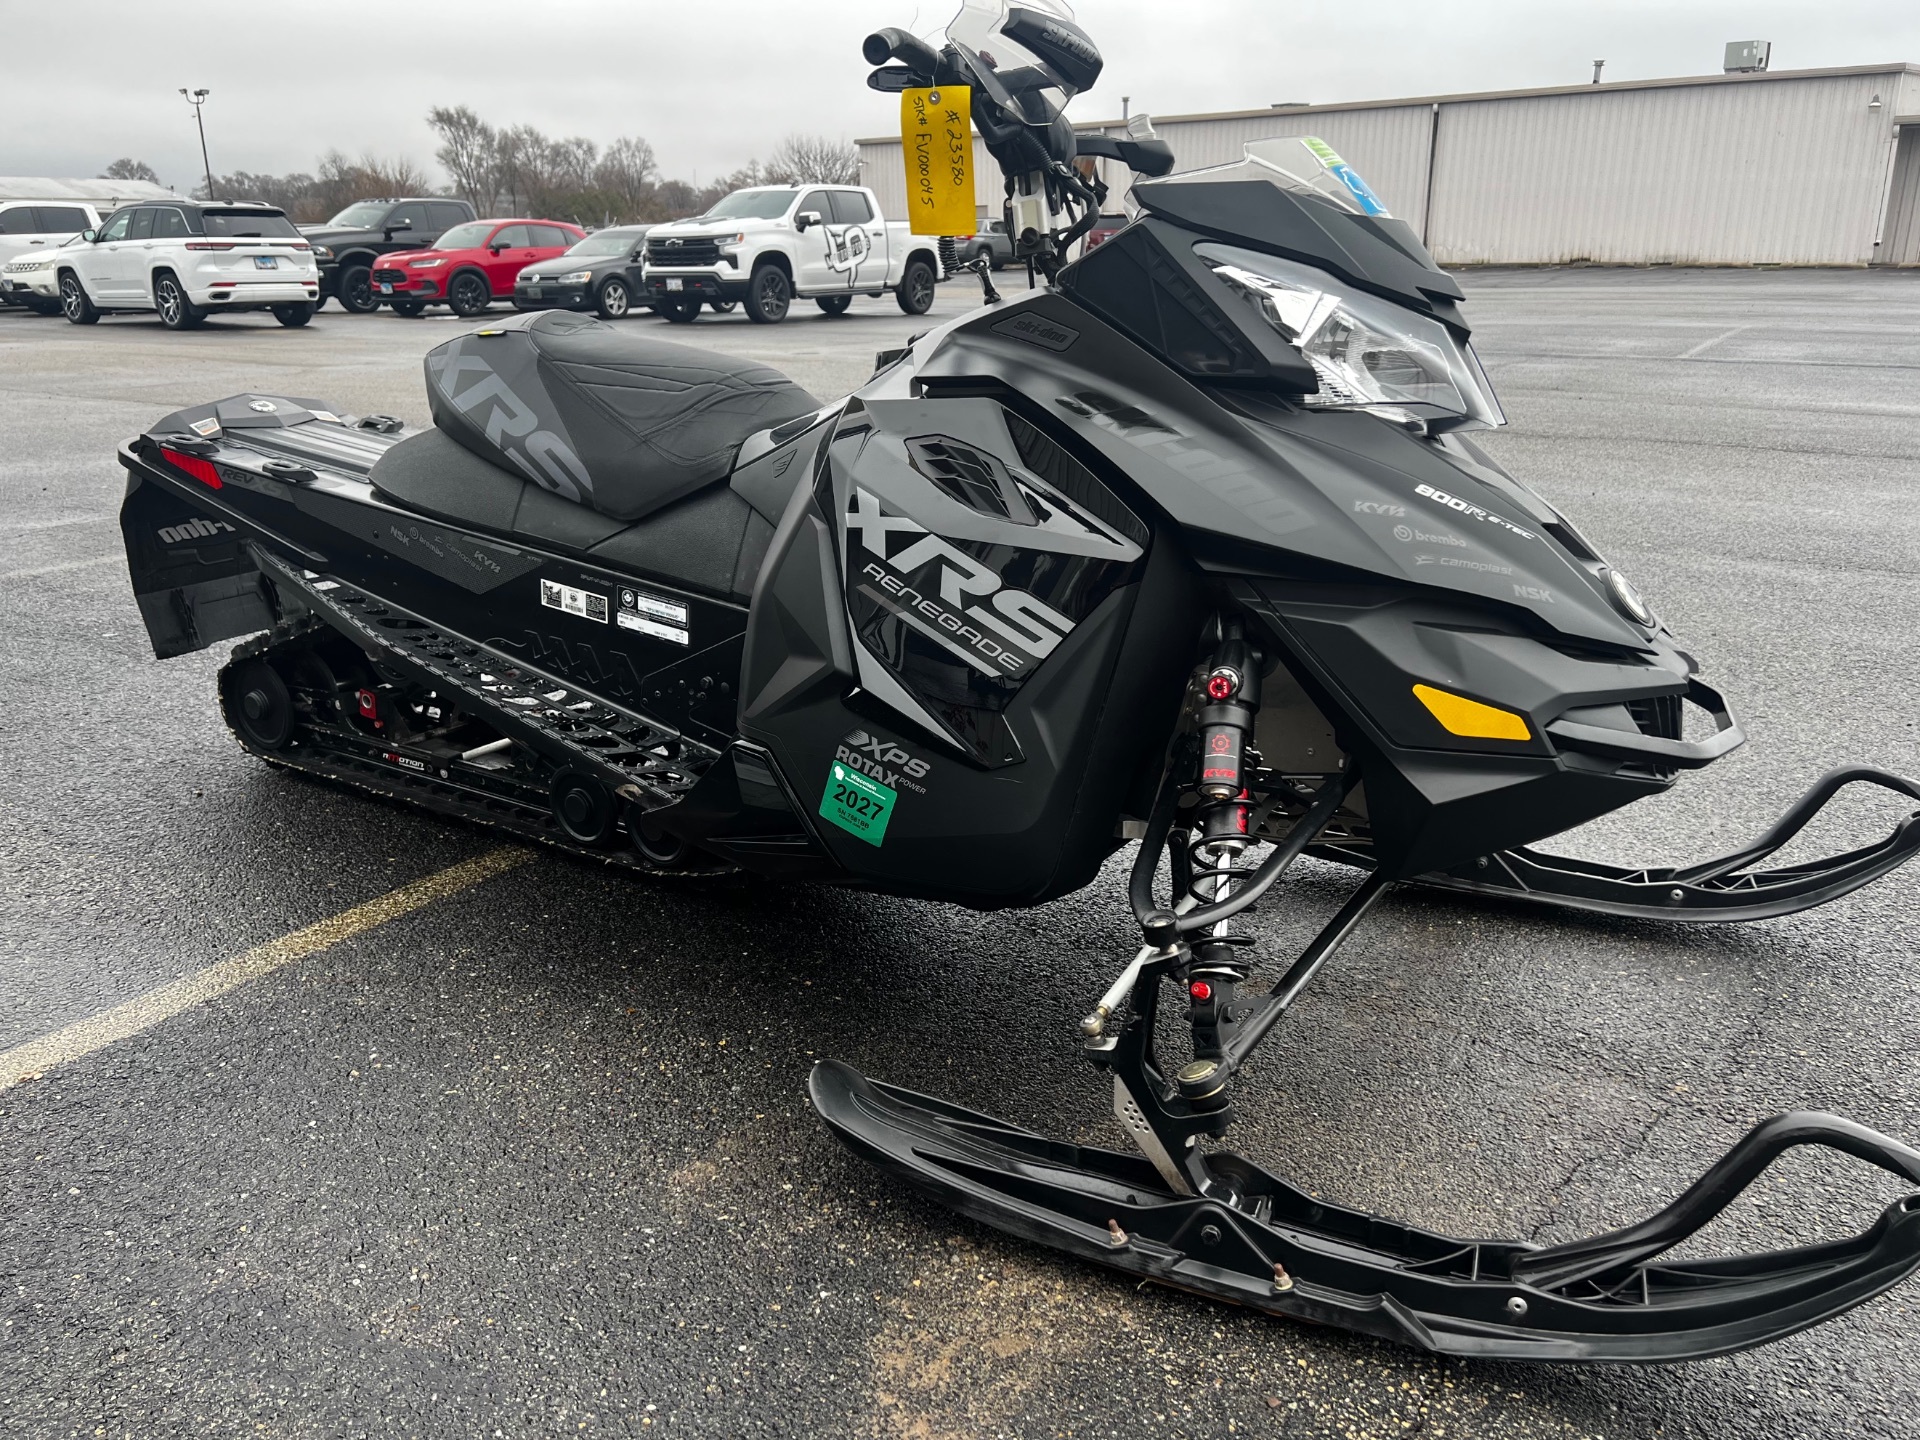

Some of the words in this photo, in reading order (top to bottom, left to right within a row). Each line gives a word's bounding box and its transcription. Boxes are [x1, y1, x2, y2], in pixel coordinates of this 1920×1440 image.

[1013, 320, 1068, 344] ski-doo
[428, 339, 593, 503] XRS
[390, 525, 410, 547] NSK
[1415, 530, 1468, 548] brembo
[1487, 516, 1535, 540] E-TEC
[418, 534, 444, 558] brembo
[445, 542, 484, 573] camoplast
[845, 486, 1077, 659] XRS
[1440, 557, 1513, 576] camoplast
[1513, 584, 1555, 603] NSK
[862, 562, 1024, 671] RENEGADE
[836, 745, 900, 789] ROTAX
[899, 777, 927, 795] POWER
[860, 736, 931, 778] XPS
[832, 783, 884, 821] 2027
